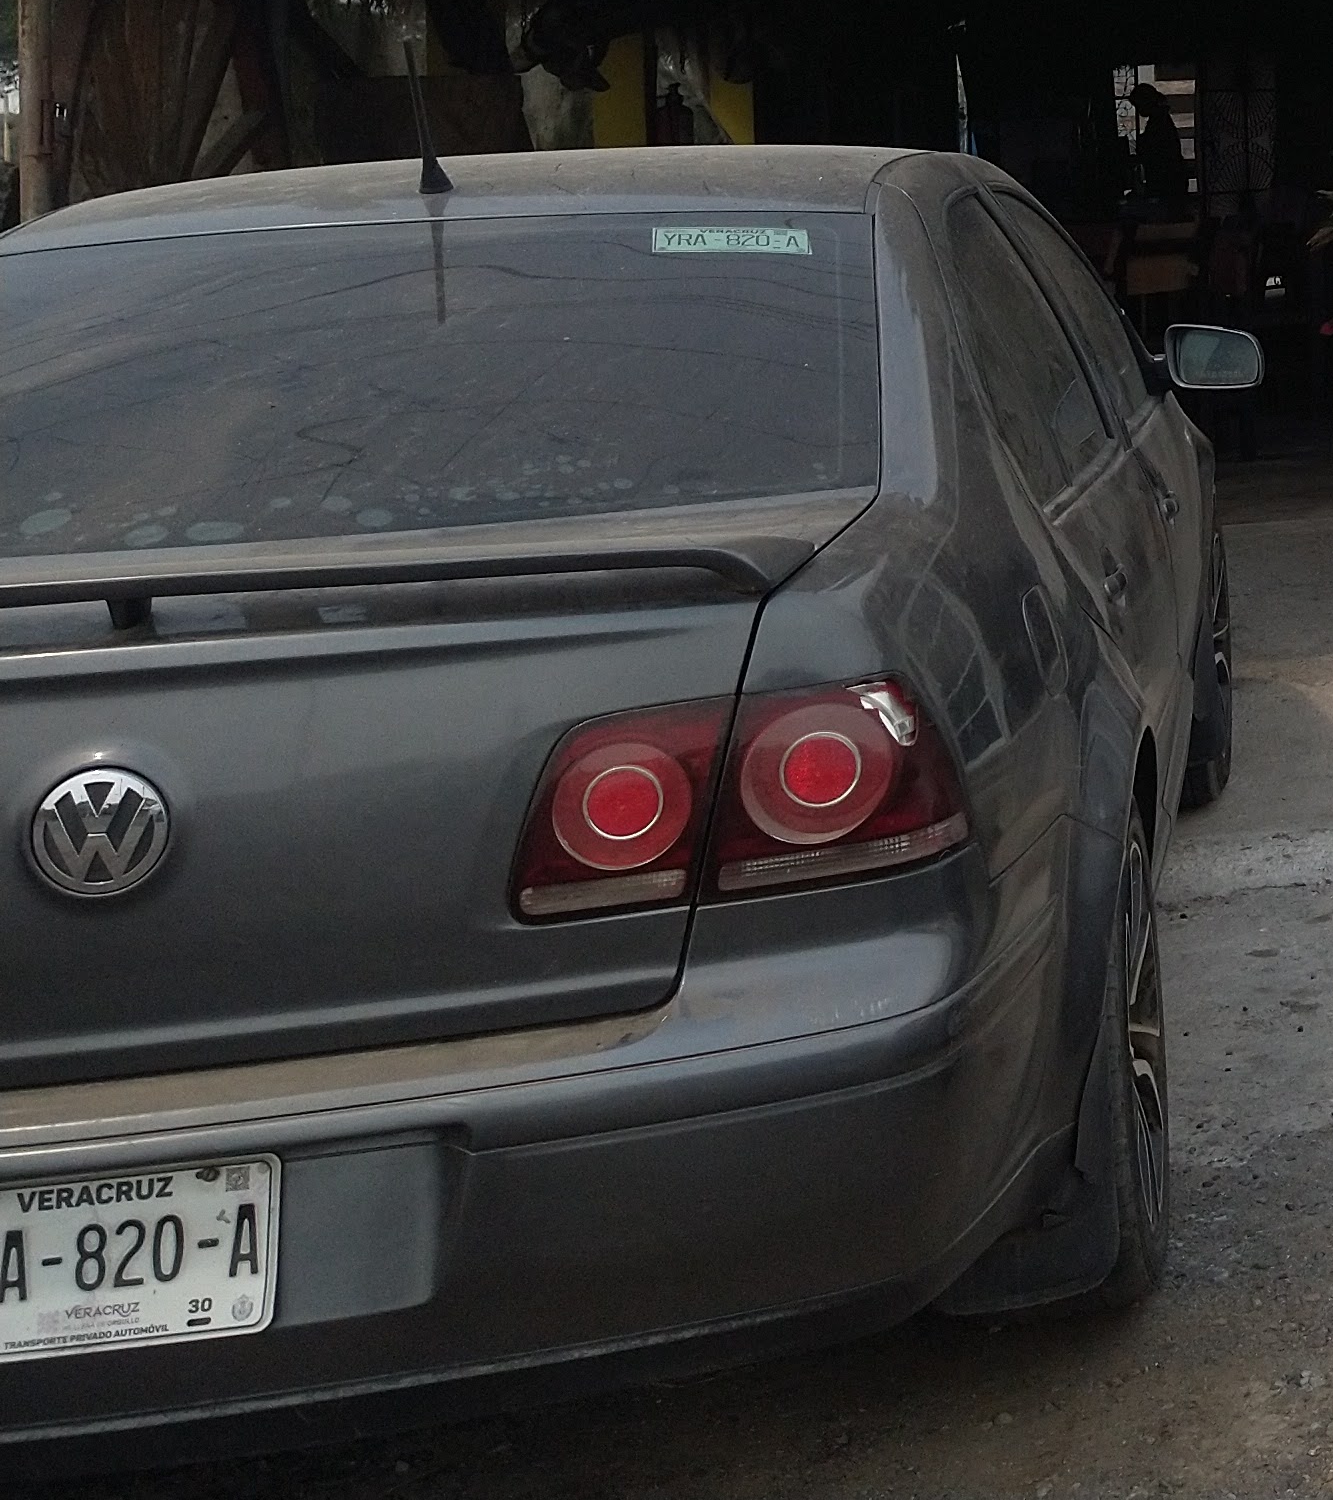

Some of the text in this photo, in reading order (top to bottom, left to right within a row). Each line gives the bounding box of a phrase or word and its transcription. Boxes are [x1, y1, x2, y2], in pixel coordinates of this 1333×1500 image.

[17, 1176, 174, 1213] VERACRUZ
[65, 1302, 140, 1320] VERACRUZ
[188, 1298, 213, 1313] 30
[4, 1323, 170, 1350] TRANSPORTE PRIVADO AUTOMÓVIL
